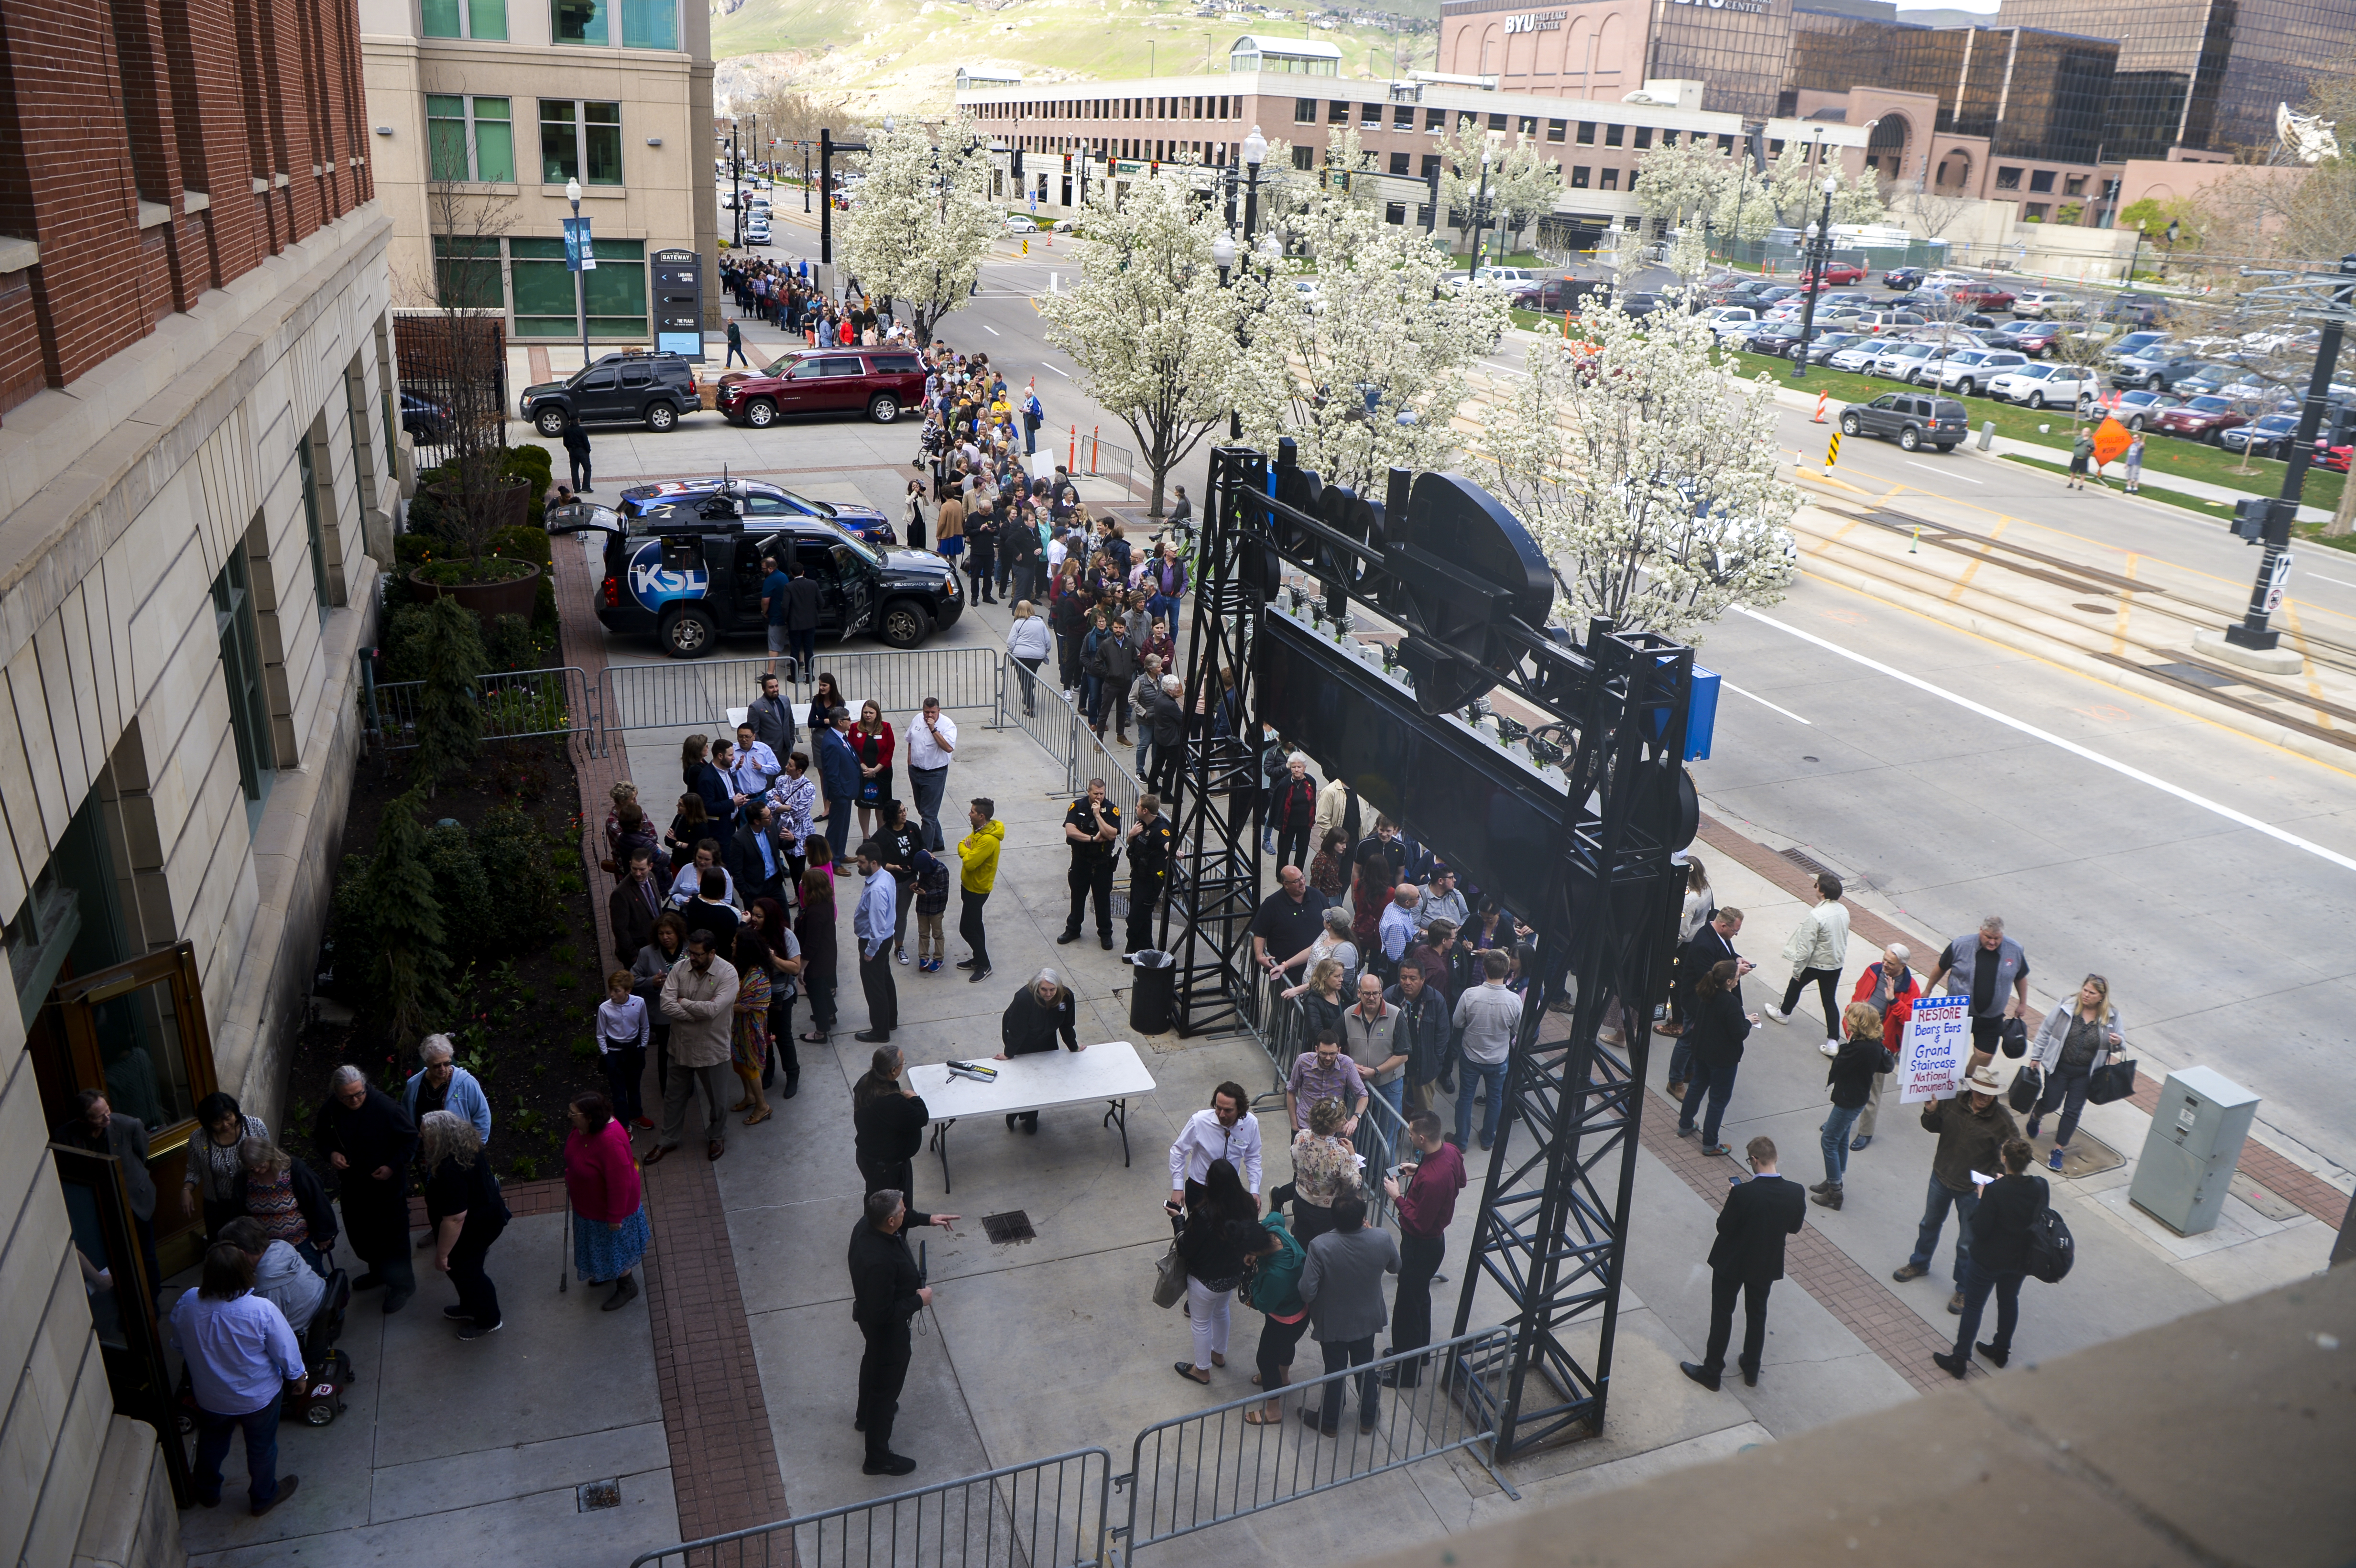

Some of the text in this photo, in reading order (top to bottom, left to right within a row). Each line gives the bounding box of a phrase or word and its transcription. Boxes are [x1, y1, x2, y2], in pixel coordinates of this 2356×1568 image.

[1725, 0, 1763, 13] CENTER
[1535, 11, 1567, 22] SALT LAKE
[1505, 14, 1536, 33] BYU
[1534, 21, 1560, 31] CENTER
[2097, 436, 2126, 445] SHOULDER
[636, 564, 707, 593] KSL
[1919, 1007, 1961, 1023] RESTORE
[1915, 1023, 1962, 1036] Bears Ears
[1934, 1034, 1941, 1044] &
[1915, 1039, 1952, 1058] Grand
[1910, 1059, 1956, 1071] Staircase
[1914, 1069, 1951, 1083] National
